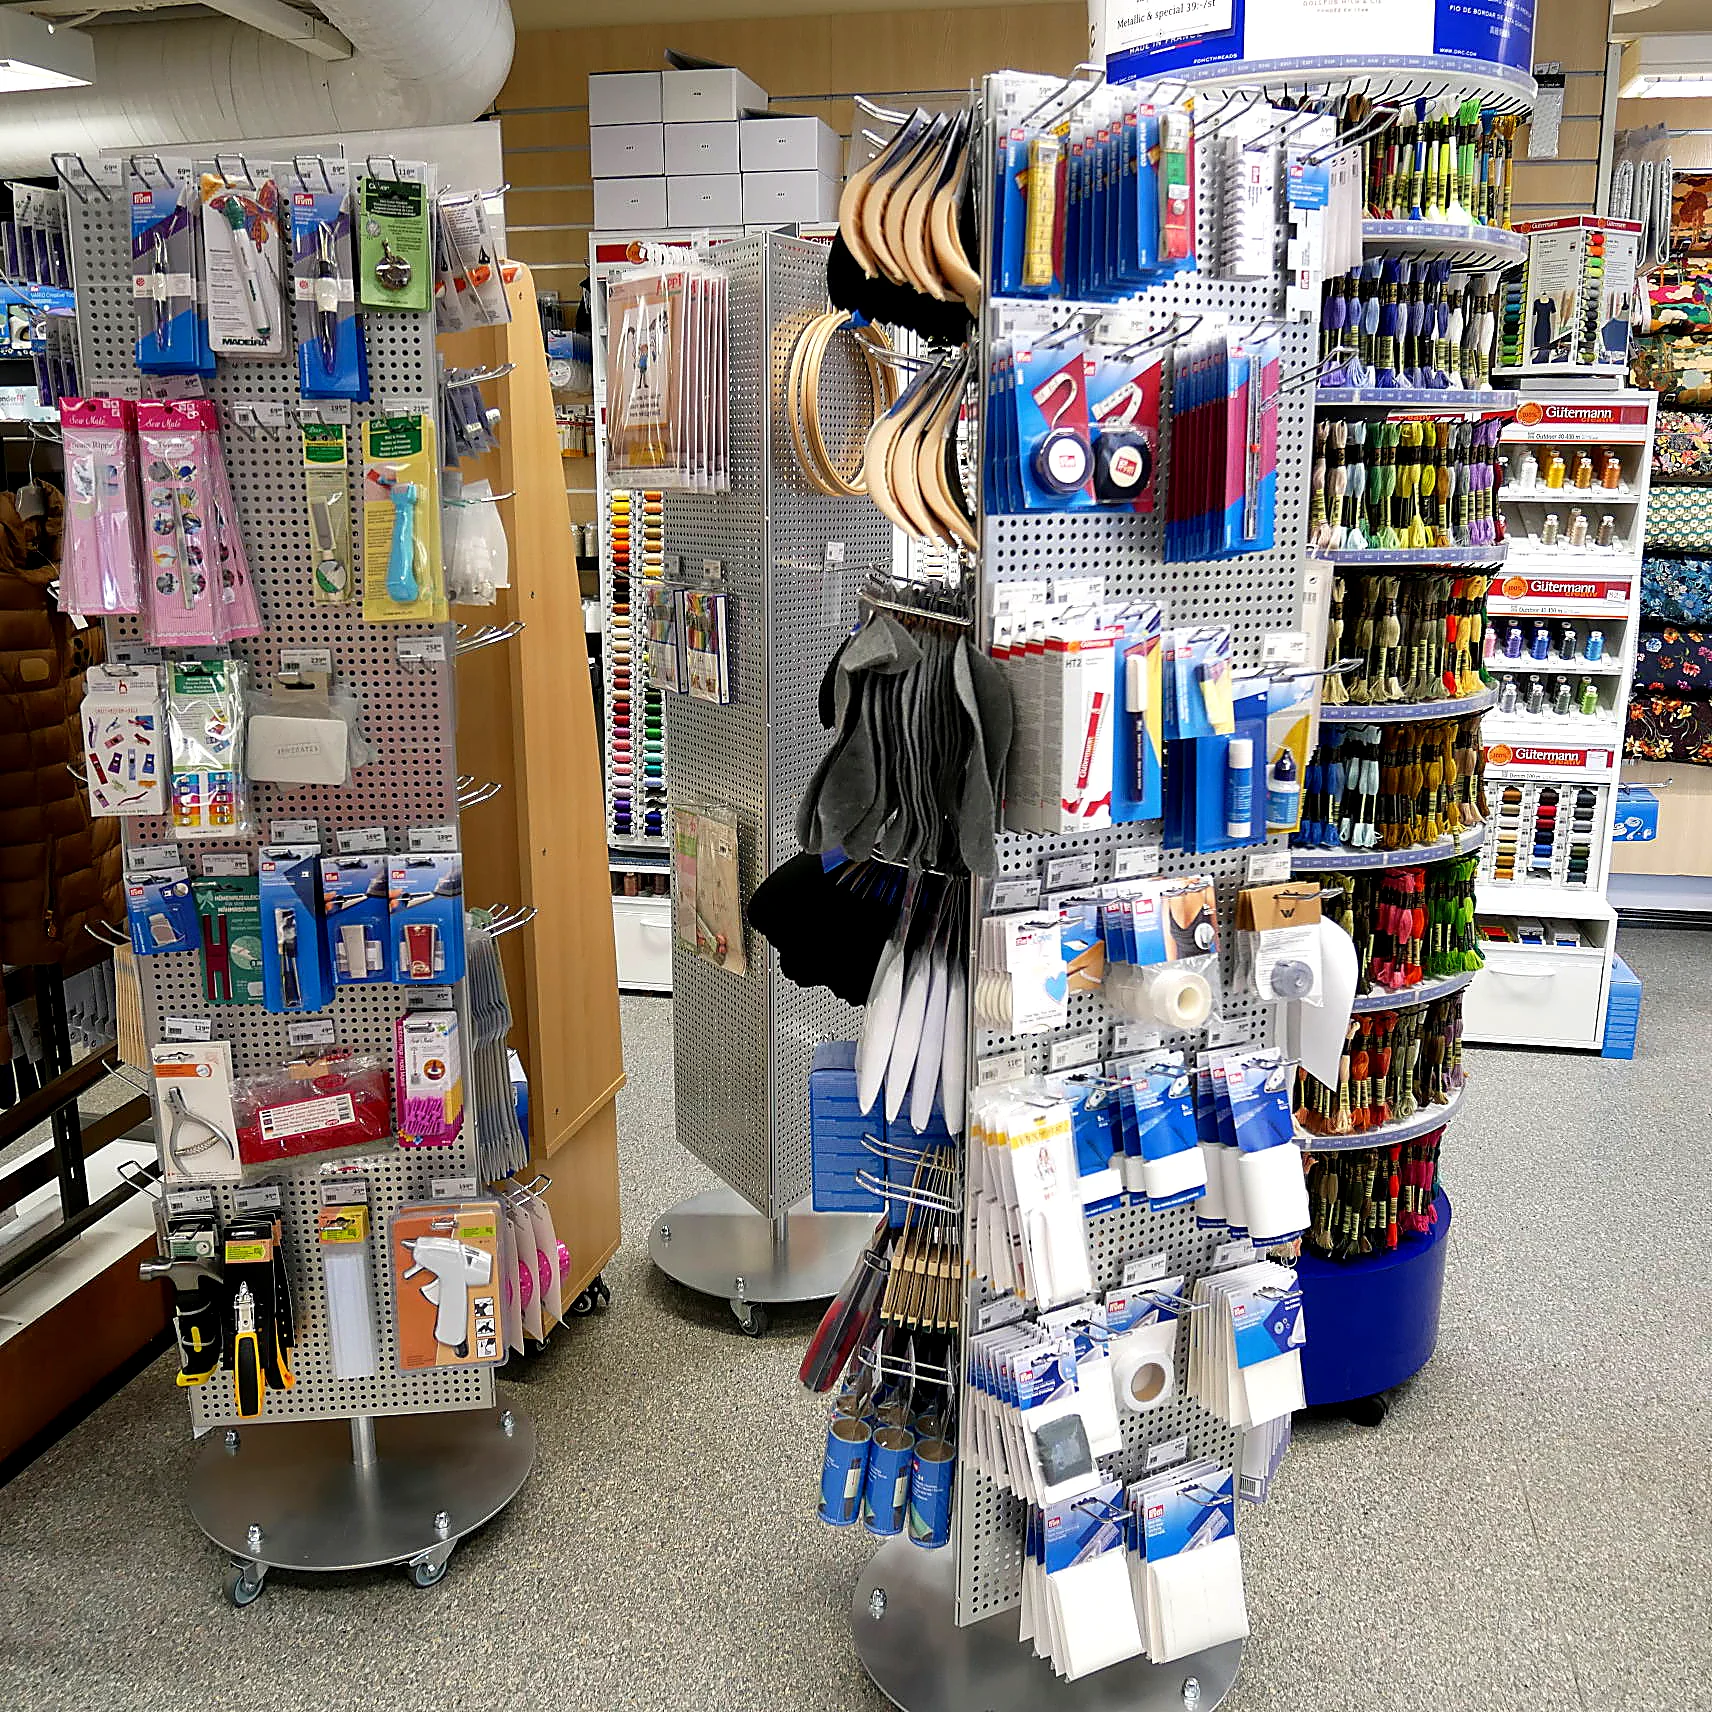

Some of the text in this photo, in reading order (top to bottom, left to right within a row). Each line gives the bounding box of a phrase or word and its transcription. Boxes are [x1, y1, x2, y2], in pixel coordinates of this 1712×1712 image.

[1117, 15, 1145, 29] Metallic
[1147, 11, 1153, 20] &
[1155, 4, 1184, 20] special
[134, 193, 151, 204] Prym
[294, 194, 313, 206] Prym
[1545, 406, 1612, 419] Gütermann
[1117, 458, 1137, 475] Prym
[1530, 580, 1595, 593] Gütermann
[1065, 659, 1082, 668] HT2
[1515, 749, 1579, 761] Gütermann
